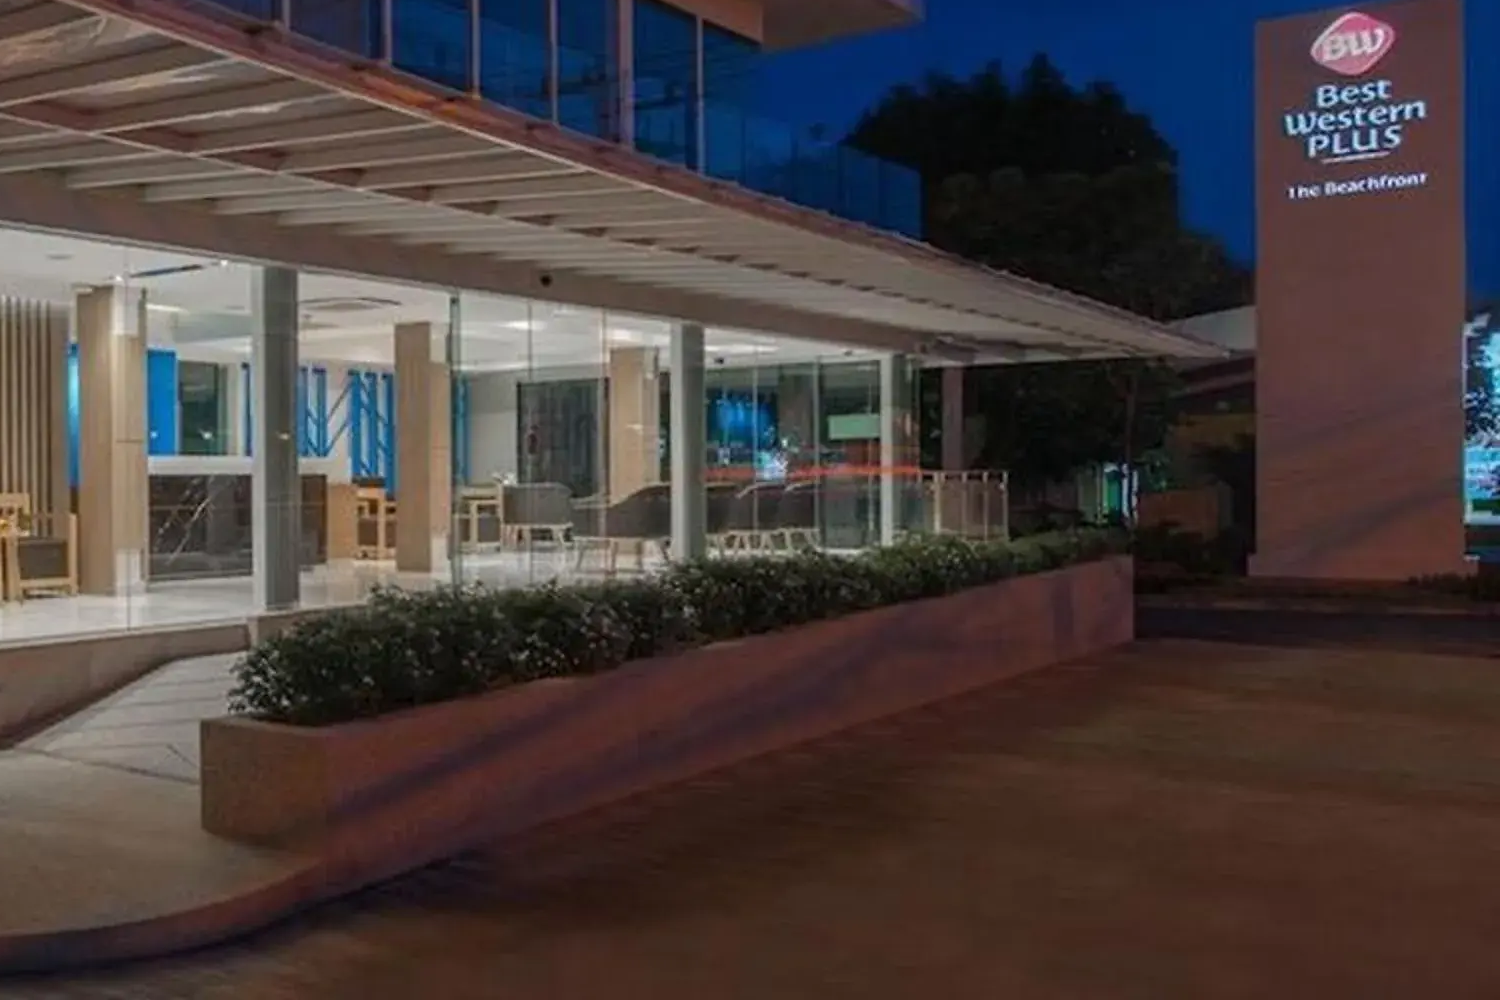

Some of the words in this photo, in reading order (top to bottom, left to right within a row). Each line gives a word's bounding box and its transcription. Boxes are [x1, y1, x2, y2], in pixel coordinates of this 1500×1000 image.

[1316, 80, 1392, 108] Best
[1284, 100, 1427, 137] Western
[1308, 124, 1402, 158] PLUS
[1287, 184, 1320, 200] The
[1325, 172, 1428, 196] Beachfront
